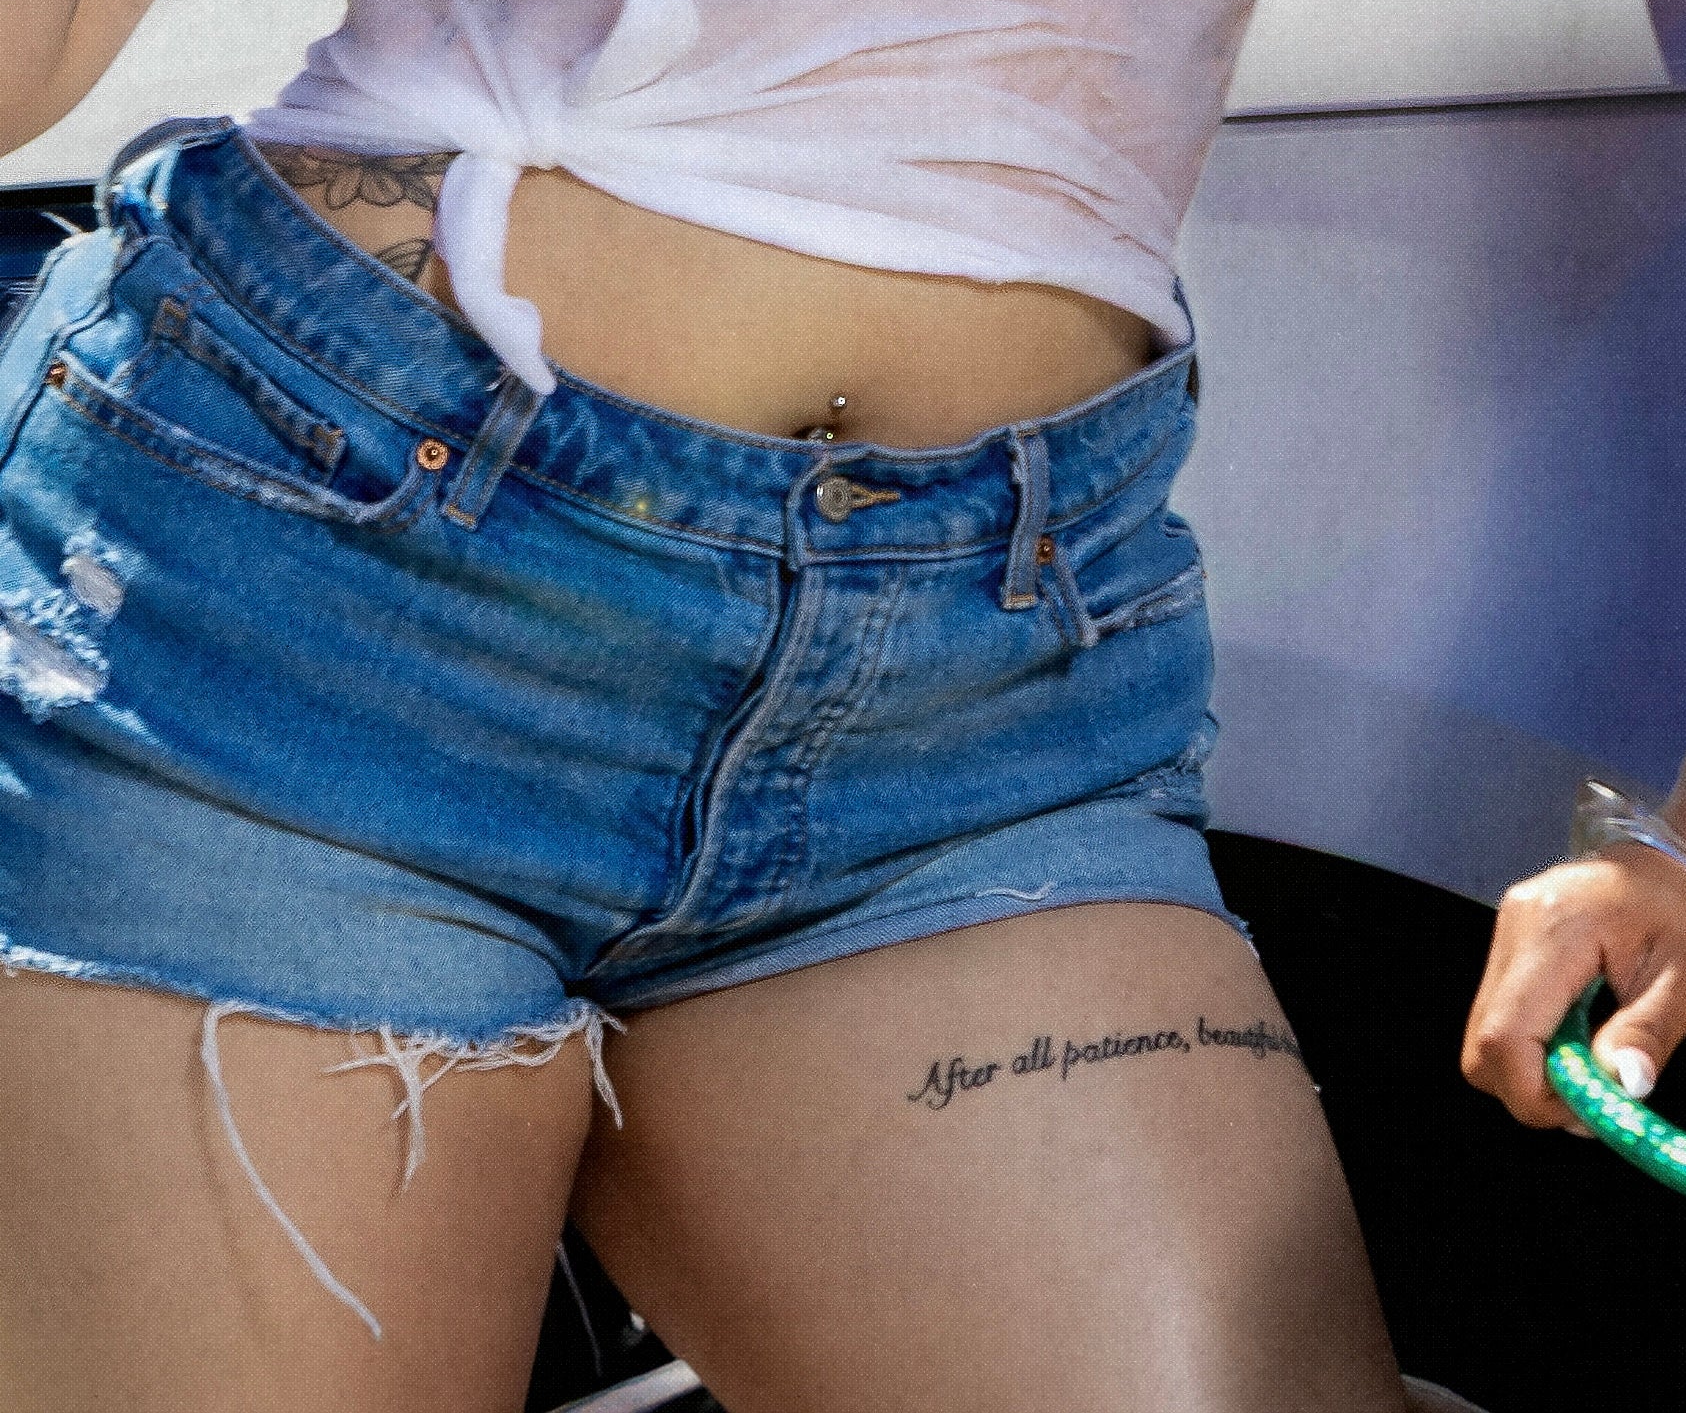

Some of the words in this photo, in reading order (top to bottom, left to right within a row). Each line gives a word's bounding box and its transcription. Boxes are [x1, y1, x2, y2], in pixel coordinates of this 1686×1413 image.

[906, 1056, 1000, 1111] After
[1012, 1036, 1055, 1075] all
[1060, 1030, 1191, 1081] patience,
